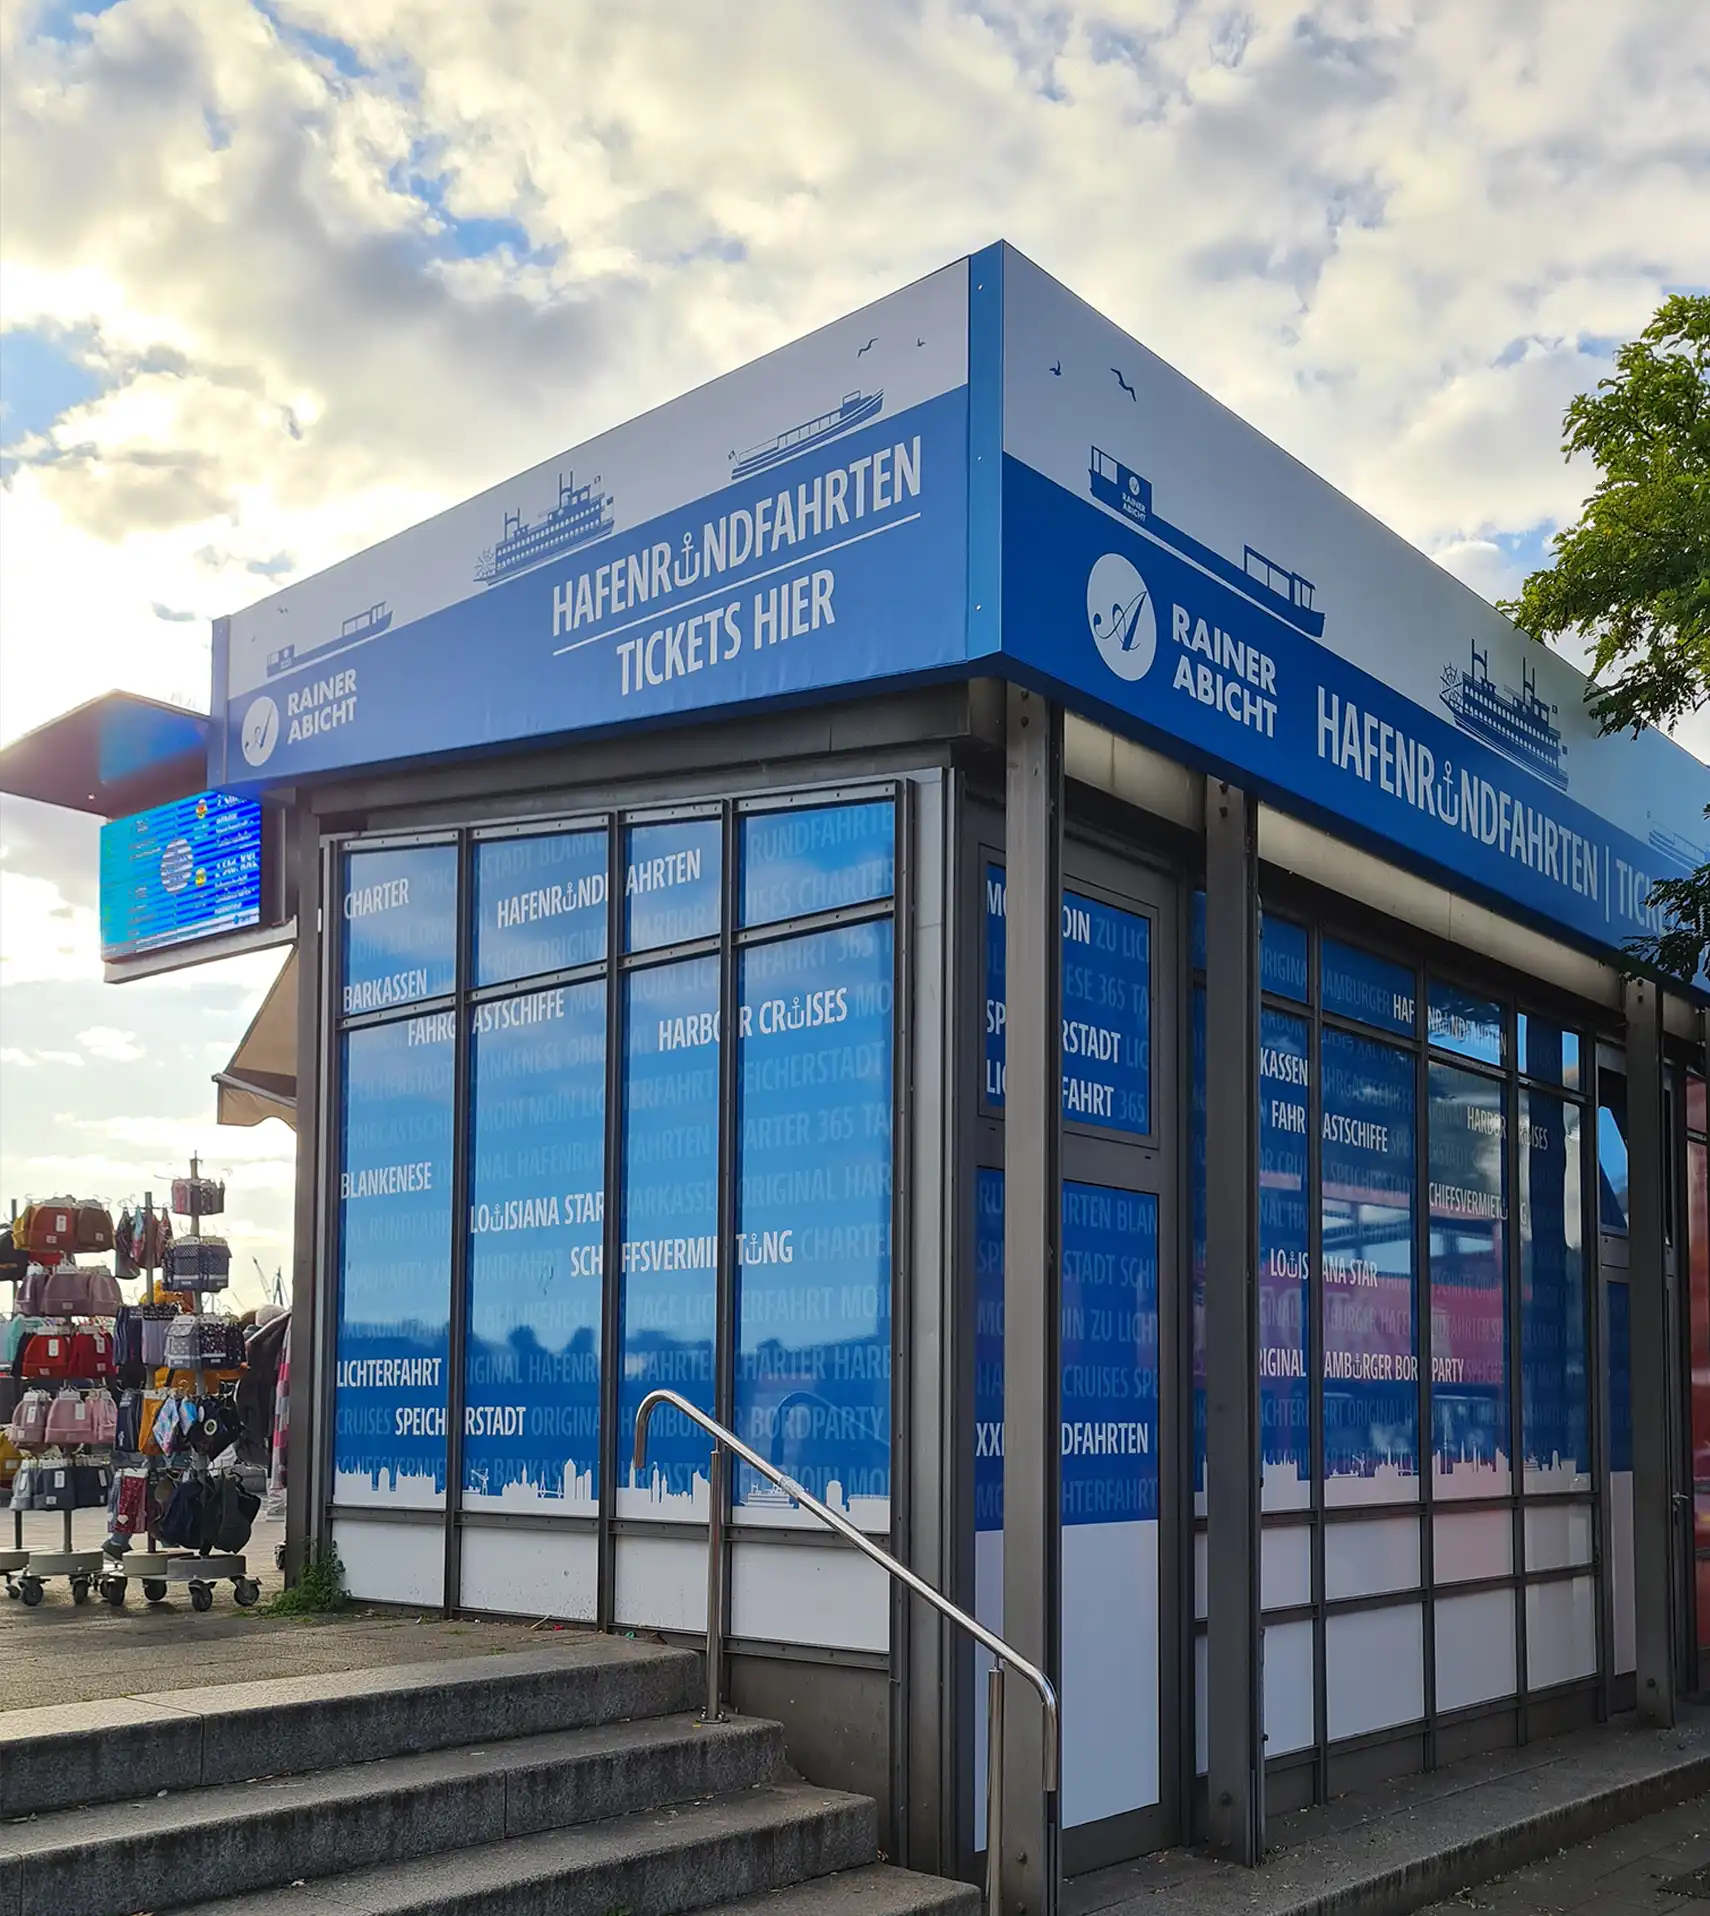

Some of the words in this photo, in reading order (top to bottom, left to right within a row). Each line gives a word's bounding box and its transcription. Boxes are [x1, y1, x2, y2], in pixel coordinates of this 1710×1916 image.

[552, 435, 922, 638] HAFENRUNDFAHRTEN
[616, 601, 742, 697] TICKETS
[753, 569, 836, 650] HIER
[1172, 602, 1278, 697] RAINER
[287, 667, 358, 717] RAINER
[1172, 653, 1279, 739] ABICHT
[286, 695, 358, 745] ABICHT
[1317, 684, 1599, 902] HAFENRUNDFAHRTEN
[344, 877, 410, 920] CHARTER
[1095, 917, 1118, 953] ZU
[343, 967, 428, 1013] BARKASSEN
[758, 986, 848, 1037] CRUISES
[1098, 973, 1126, 1012] 365
[1117, 1089, 1147, 1123] 365
[1272, 1099, 1389, 1153] FAHRASTSCHIFFE
[341, 1161, 433, 1200] BLANKENESE
[817, 1106, 855, 1145] 365
[564, 1191, 605, 1225] STAR
[1349, 1258, 1379, 1288] STAR
[1091, 1309, 1113, 1343] ZU
[337, 1357, 443, 1389] LICHTERFAHRT
[1062, 1365, 1129, 1401] CRUISES
[1395, 1354, 1465, 1384] BORPARTY
[335, 1405, 392, 1437] CRUISES
[394, 1406, 526, 1437] SPEICHRSTADT
[750, 1402, 885, 1440] BORDPARTY
